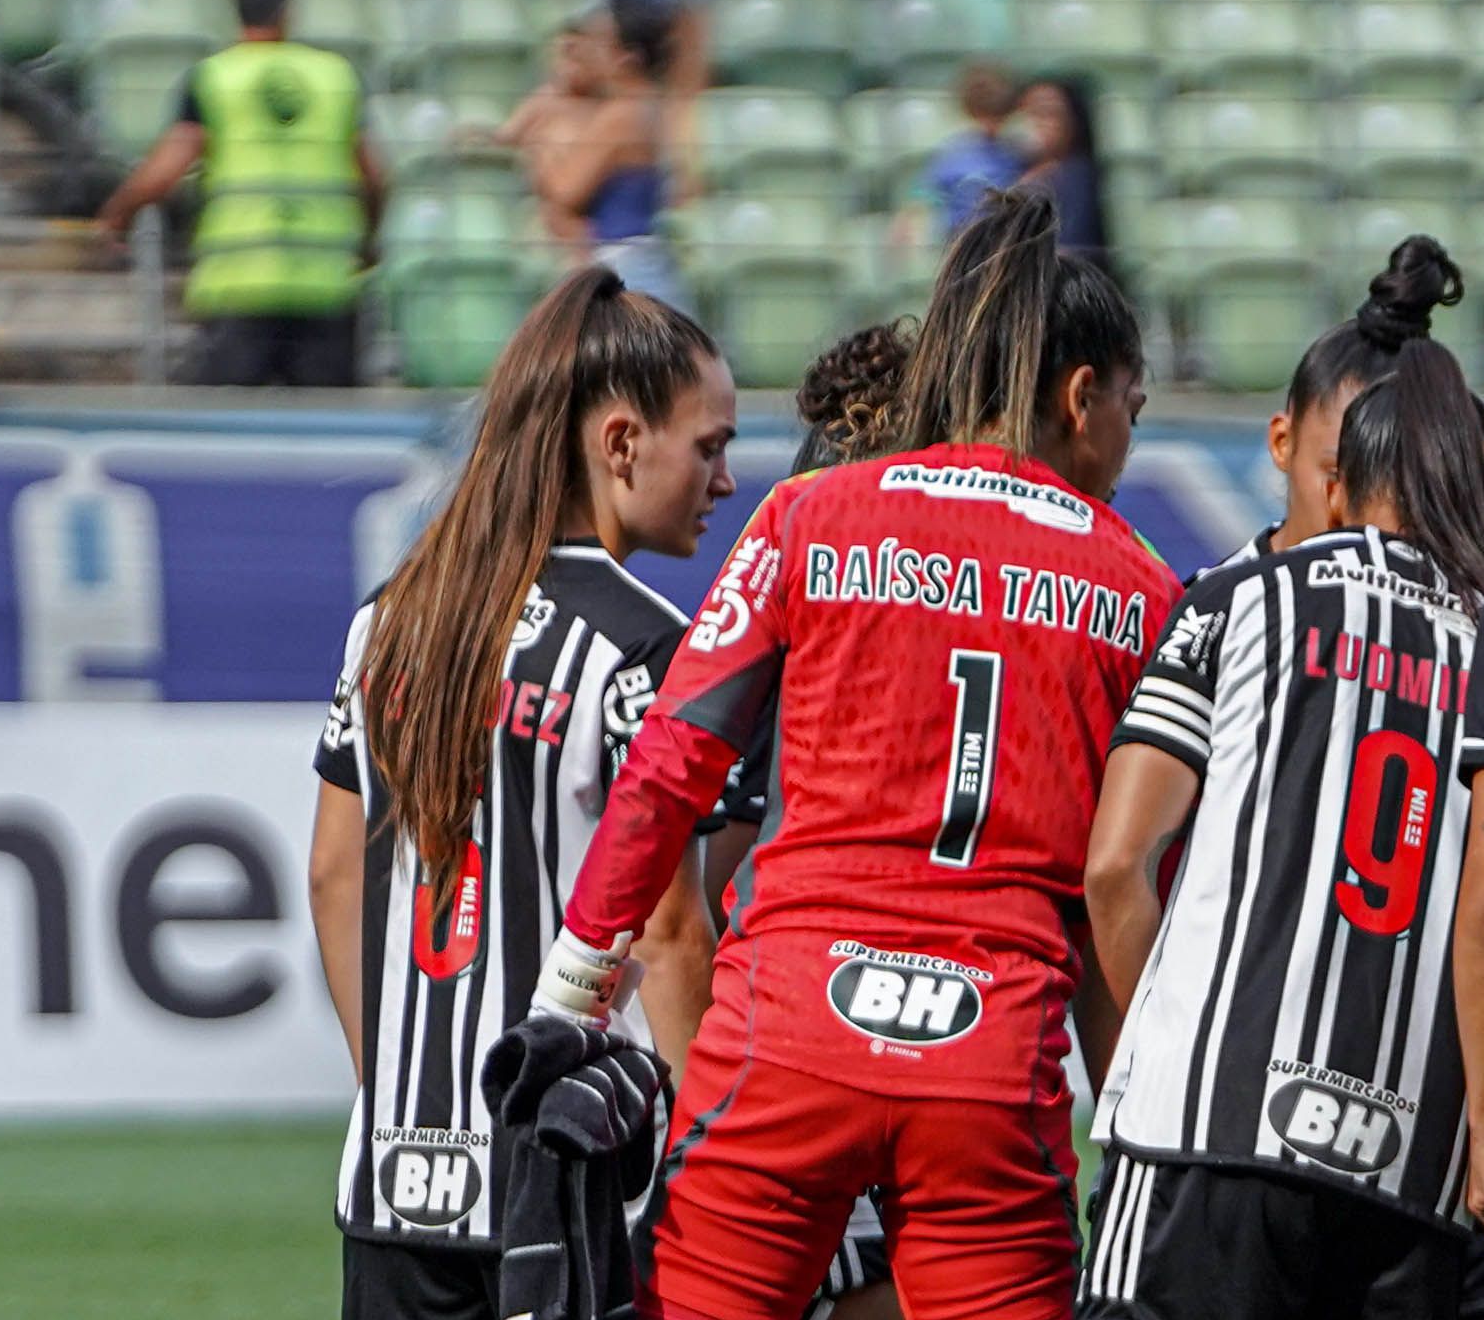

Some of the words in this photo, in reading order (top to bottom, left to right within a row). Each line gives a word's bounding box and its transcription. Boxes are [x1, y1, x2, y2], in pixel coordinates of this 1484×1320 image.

[805, 537, 984, 617] RAÍSSA
[999, 564, 1147, 655] TAYNÁ
[929, 647, 1004, 868] 1
[1334, 728, 1438, 937] 9
[830, 940, 994, 981] SUPERMERCADOS
[849, 966, 966, 1032] BH
[1269, 1058, 1416, 1113] SUPERMERCADOS
[373, 1128, 491, 1147] SUPERMERCADOS
[1285, 1087, 1392, 1166] BH
[393, 1151, 471, 1212] BH
